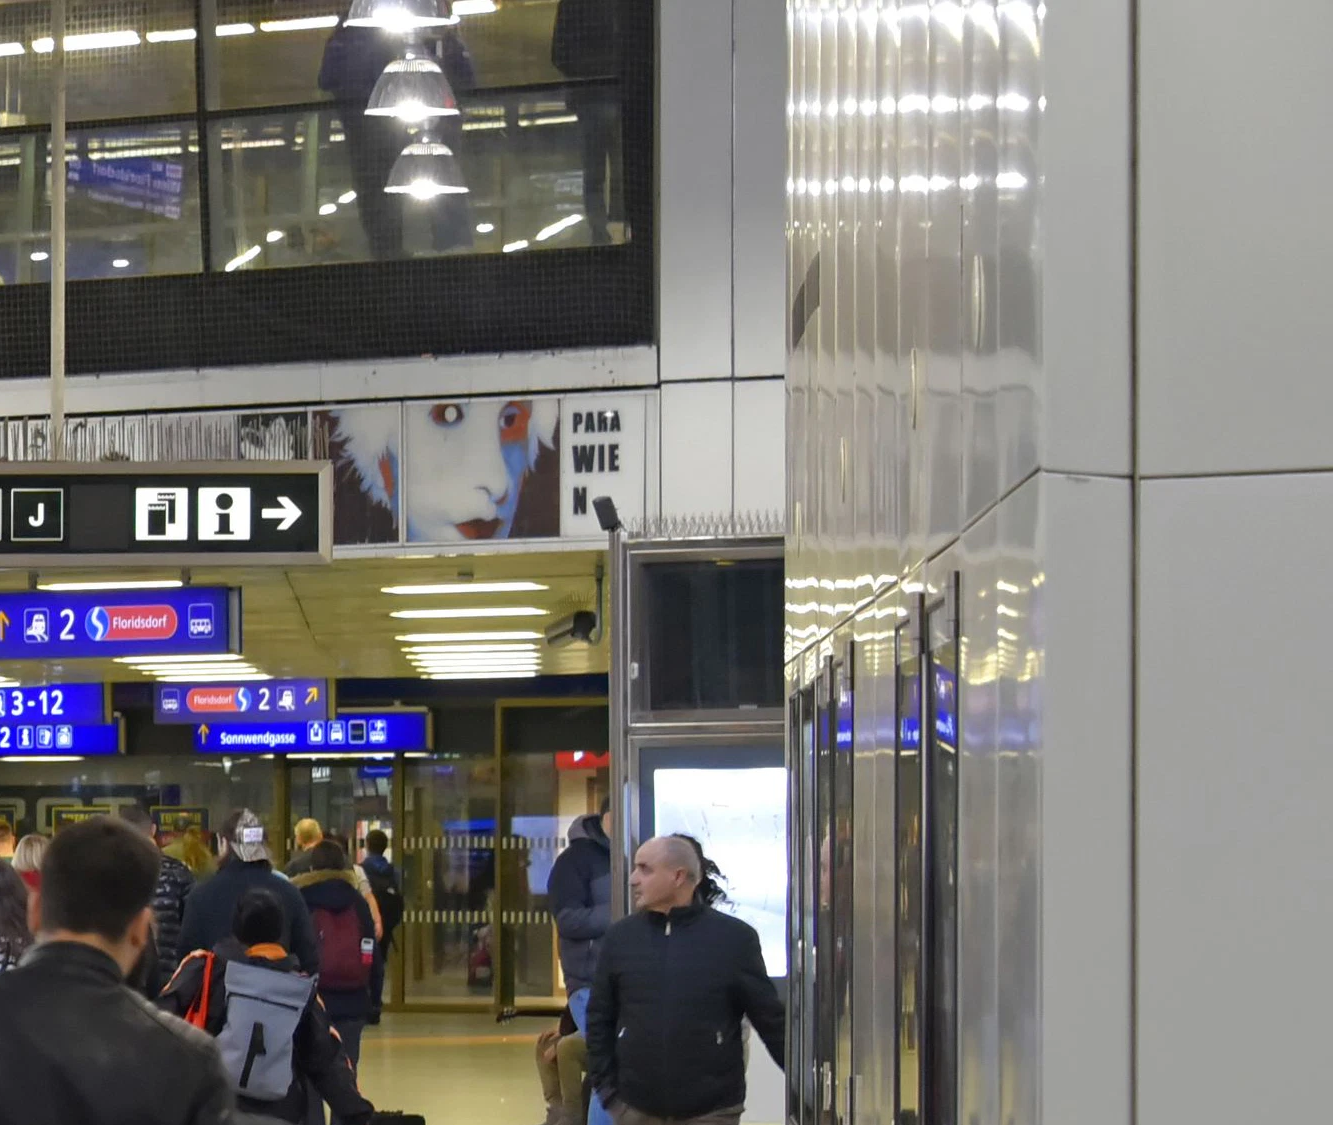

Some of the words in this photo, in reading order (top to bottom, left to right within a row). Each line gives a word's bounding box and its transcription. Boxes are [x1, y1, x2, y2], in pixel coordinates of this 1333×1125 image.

[572, 410, 621, 433] PARA
[572, 443, 620, 473] WIE
[572, 486, 587, 515] N
[28, 503, 44, 527] J
[59, 608, 75, 640] 2
[112, 614, 168, 629] Floridsdorf
[11, 690, 64, 716] 3-12
[194, 690, 231, 705] Floridsdorf
[259, 688, 270, 710] 2
[220, 731, 296, 747] Sonnwendgasse
